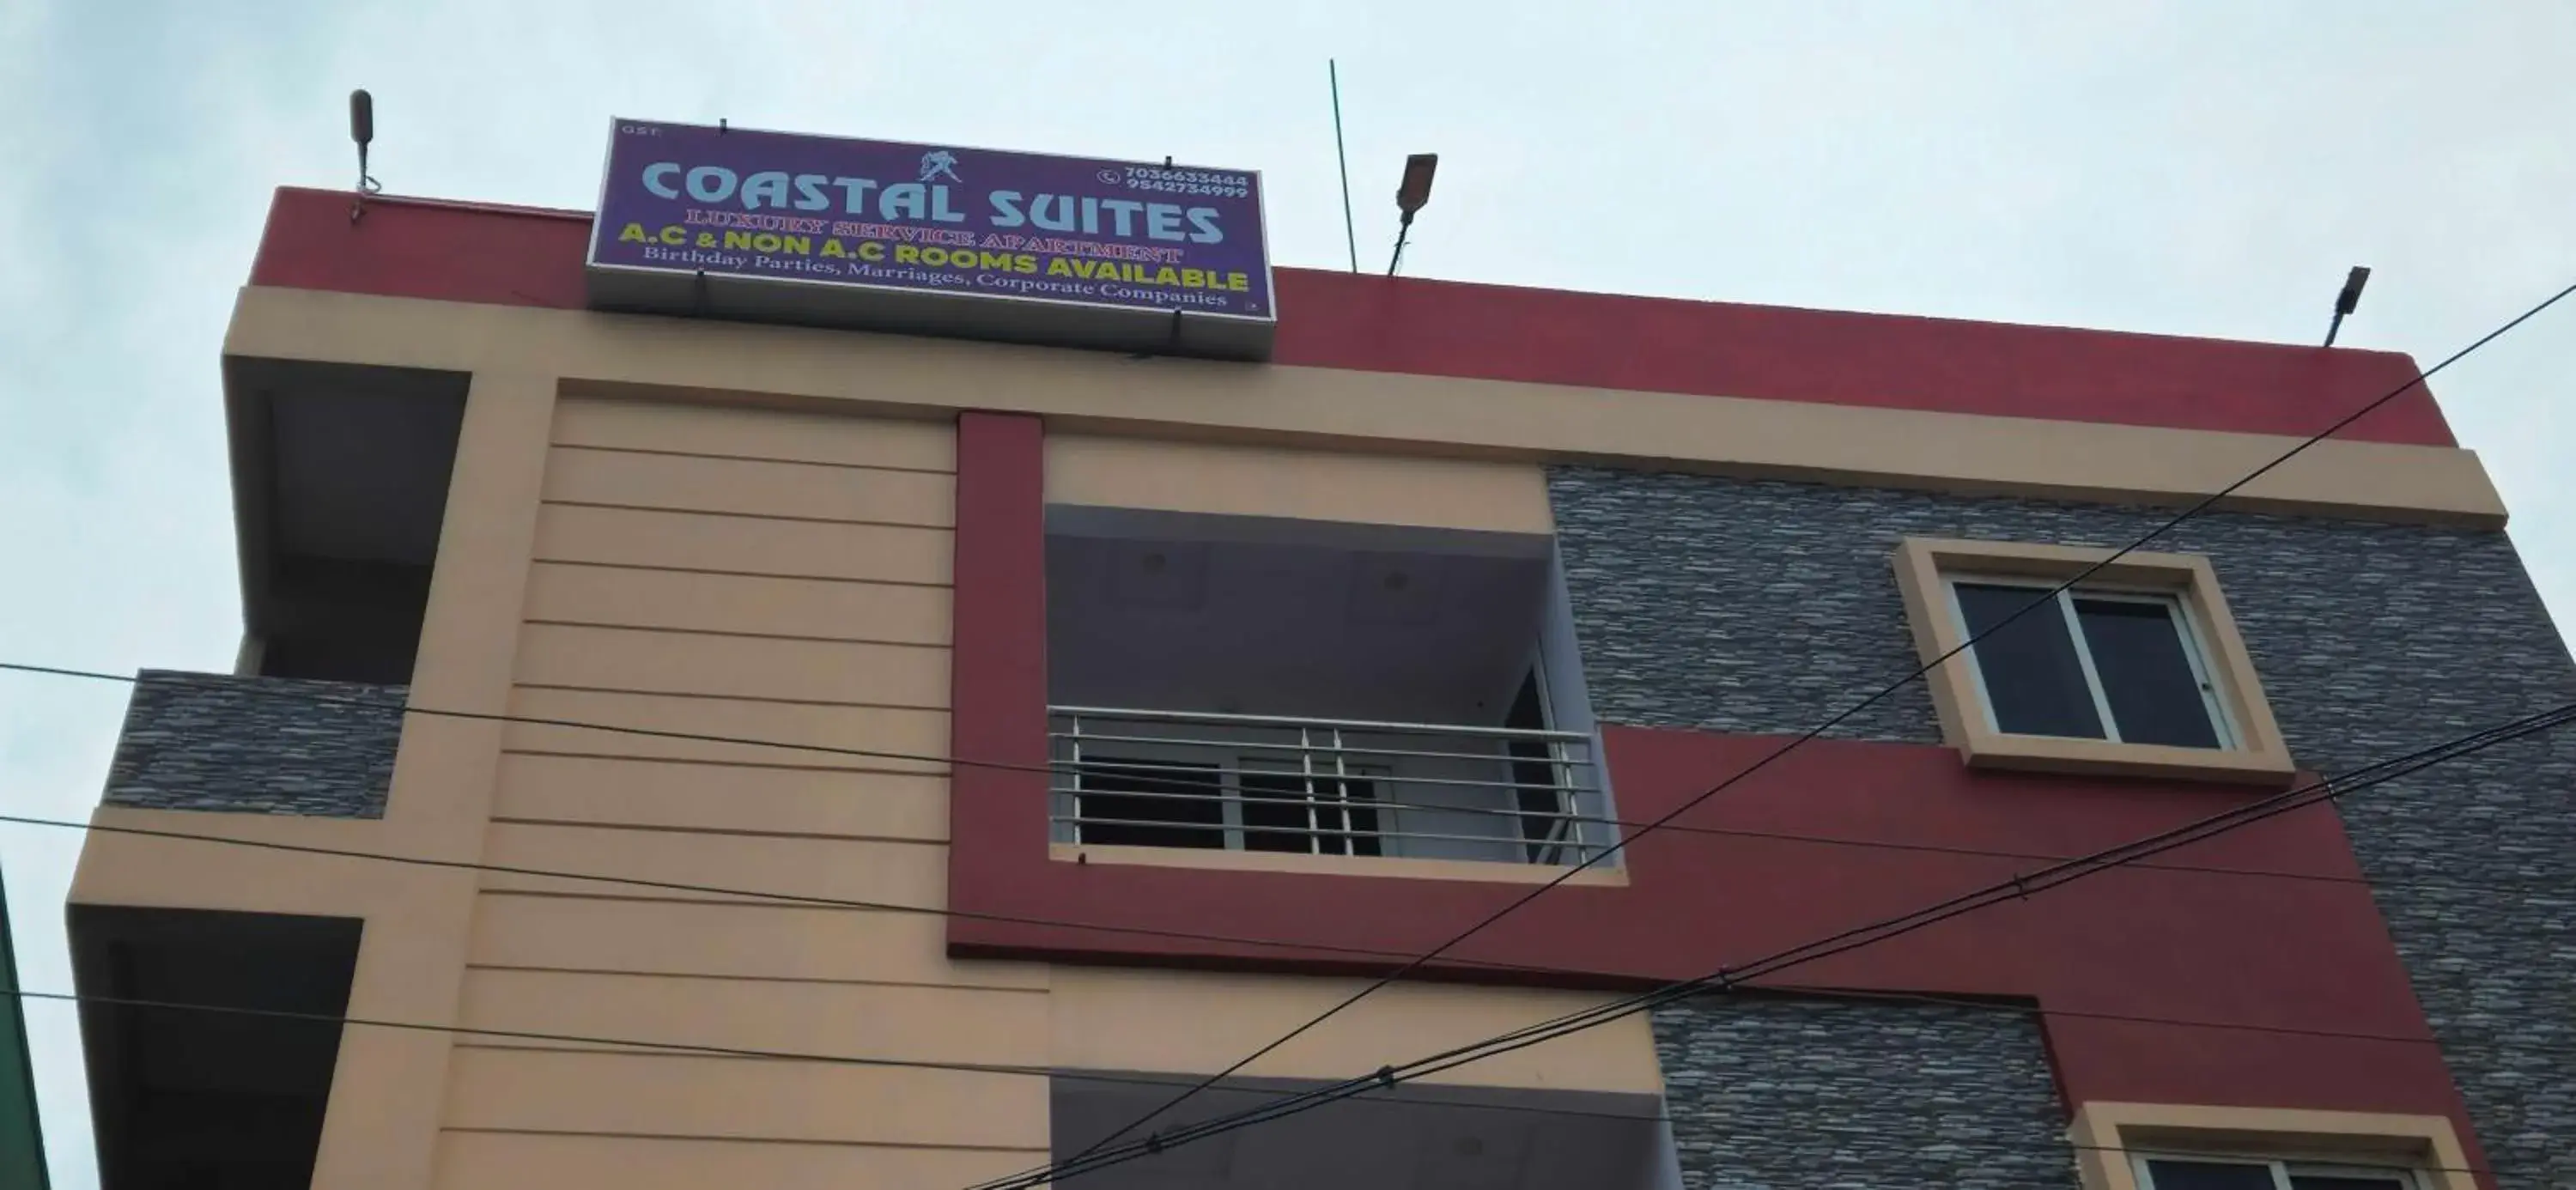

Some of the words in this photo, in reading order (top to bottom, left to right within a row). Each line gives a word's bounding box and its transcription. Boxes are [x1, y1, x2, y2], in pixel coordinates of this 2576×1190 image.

[642, 161, 966, 222] COASTAL
[988, 189, 1224, 245] SUITES
[1126, 178, 1249, 198] 9542734999
[618, 222, 687, 246] A.C
[696, 232, 717, 248] &
[724, 230, 811, 256] NON
[819, 238, 885, 262] A.C
[895, 244, 1038, 275] ROOMS
[1046, 258, 1250, 293] AVAILABLE
[684, 209, 829, 235] LUXURY
[832, 221, 976, 247] SERVICE
[979, 232, 1184, 264] APARTMENT
[644, 246, 748, 270] Birthday
[755, 254, 841, 276] Parties,
[848, 263, 971, 287] Marriages,
[976, 272, 1095, 295] Corporate
[1100, 284, 1228, 307] Companies
